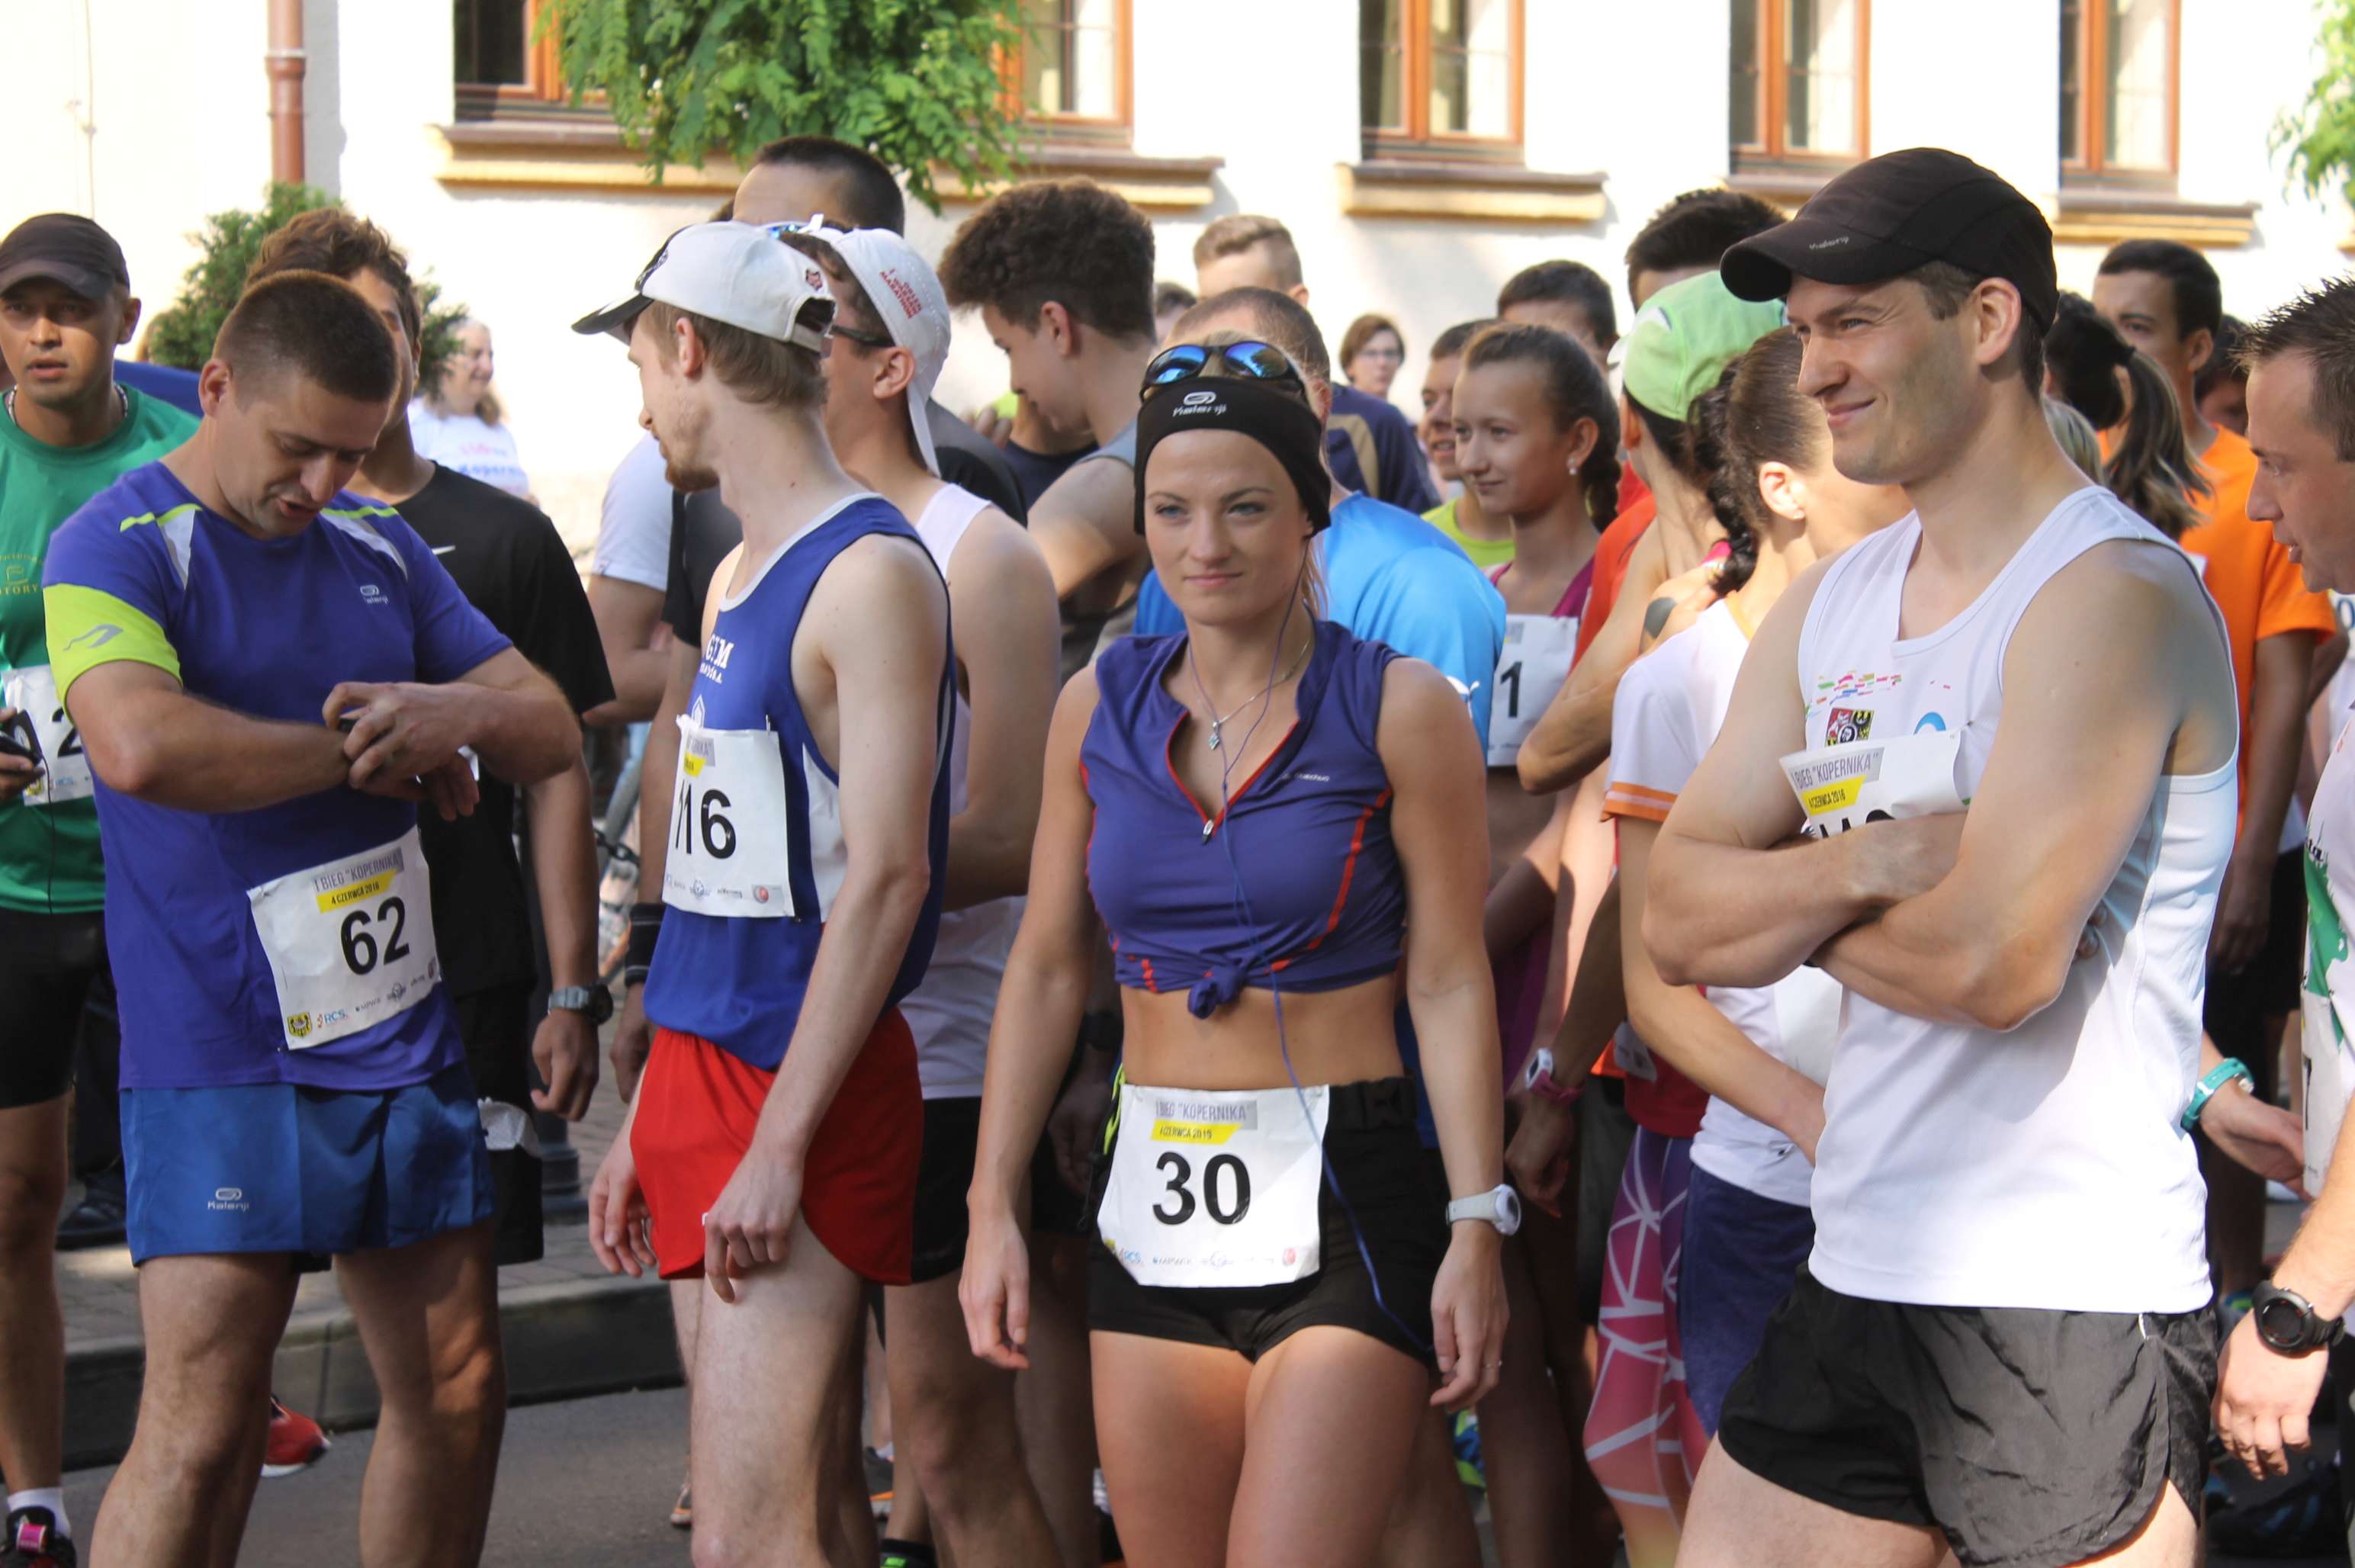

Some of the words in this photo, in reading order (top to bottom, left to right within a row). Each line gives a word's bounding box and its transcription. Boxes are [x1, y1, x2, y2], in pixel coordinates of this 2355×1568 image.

[321, 872, 345, 891] BIEG
[341, 895, 410, 976] 62
[1152, 1151, 1251, 1226] 30
